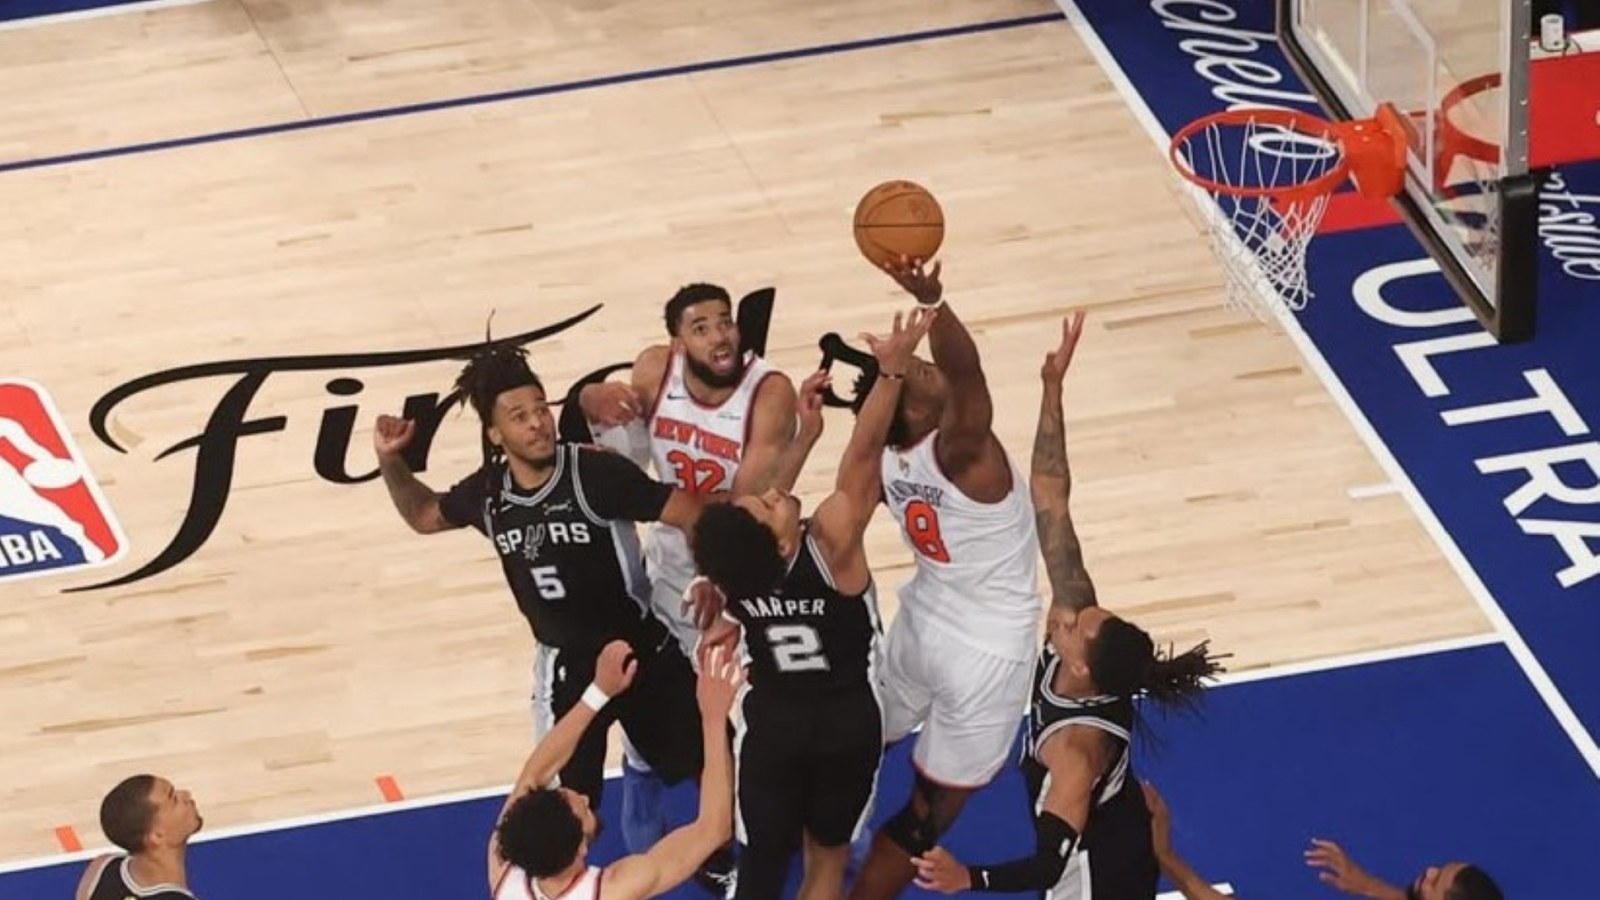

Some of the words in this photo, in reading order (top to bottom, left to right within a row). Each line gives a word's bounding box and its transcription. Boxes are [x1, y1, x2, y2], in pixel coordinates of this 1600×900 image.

[654, 416, 695, 445] NEW
[693, 427, 741, 463] YORK
[666, 449, 726, 493] 32
[496, 521, 591, 561] SPURS
[904, 499, 952, 565] 8
[530, 565, 567, 600] 5
[740, 596, 826, 618] HARPER
[765, 624, 831, 673] 2
